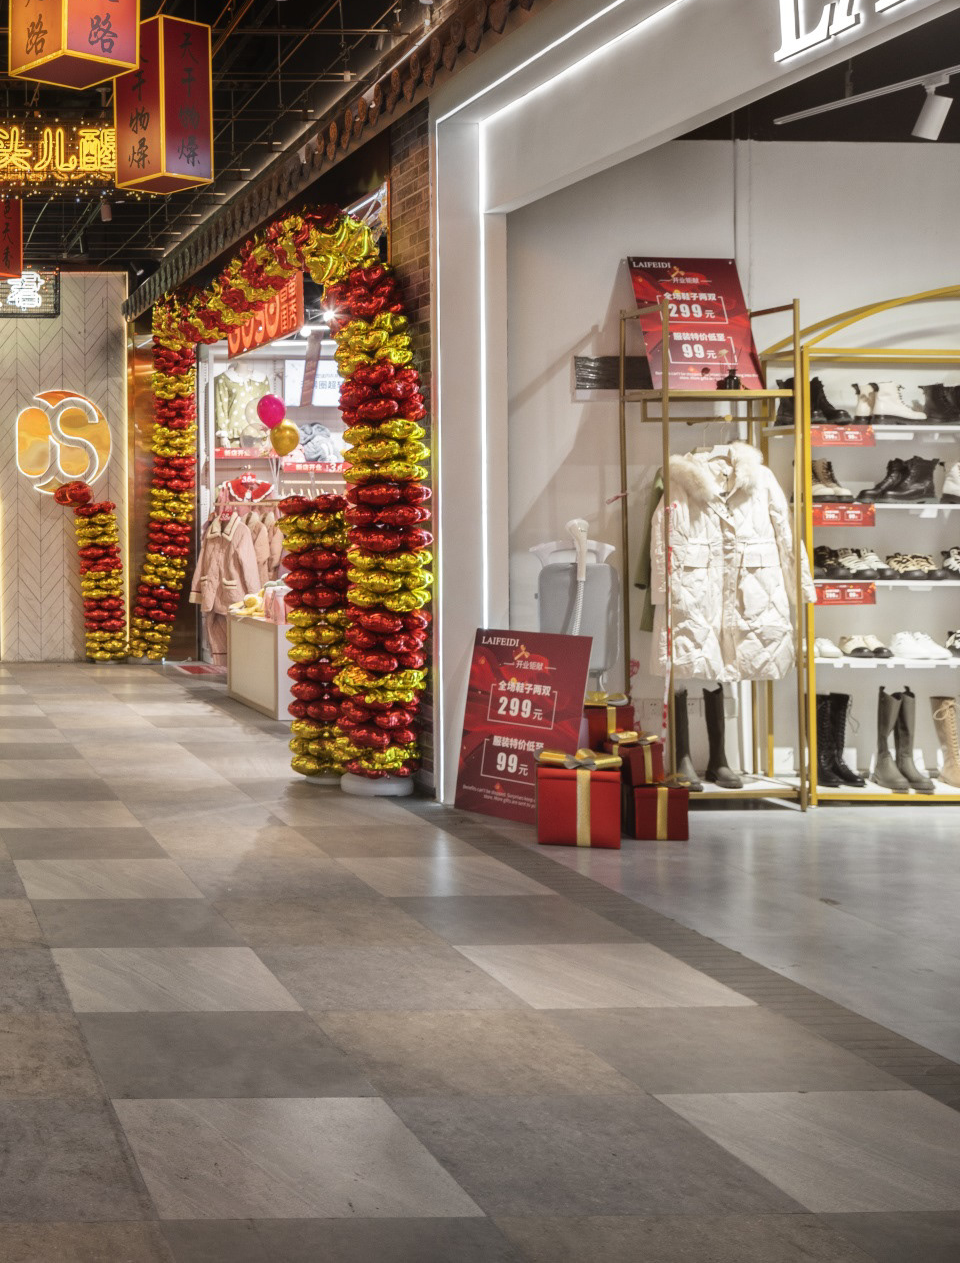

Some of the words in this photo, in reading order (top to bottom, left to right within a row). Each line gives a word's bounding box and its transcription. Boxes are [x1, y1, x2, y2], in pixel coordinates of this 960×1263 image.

[632, 261, 671, 269] LAIFEIDI
[681, 343, 718, 359] 99元
[481, 636, 520, 647] LAIFEIDI
[497, 680, 552, 697] 全场鞋子两双
[497, 696, 543, 721] 299元
[496, 752, 529, 777] 99元
